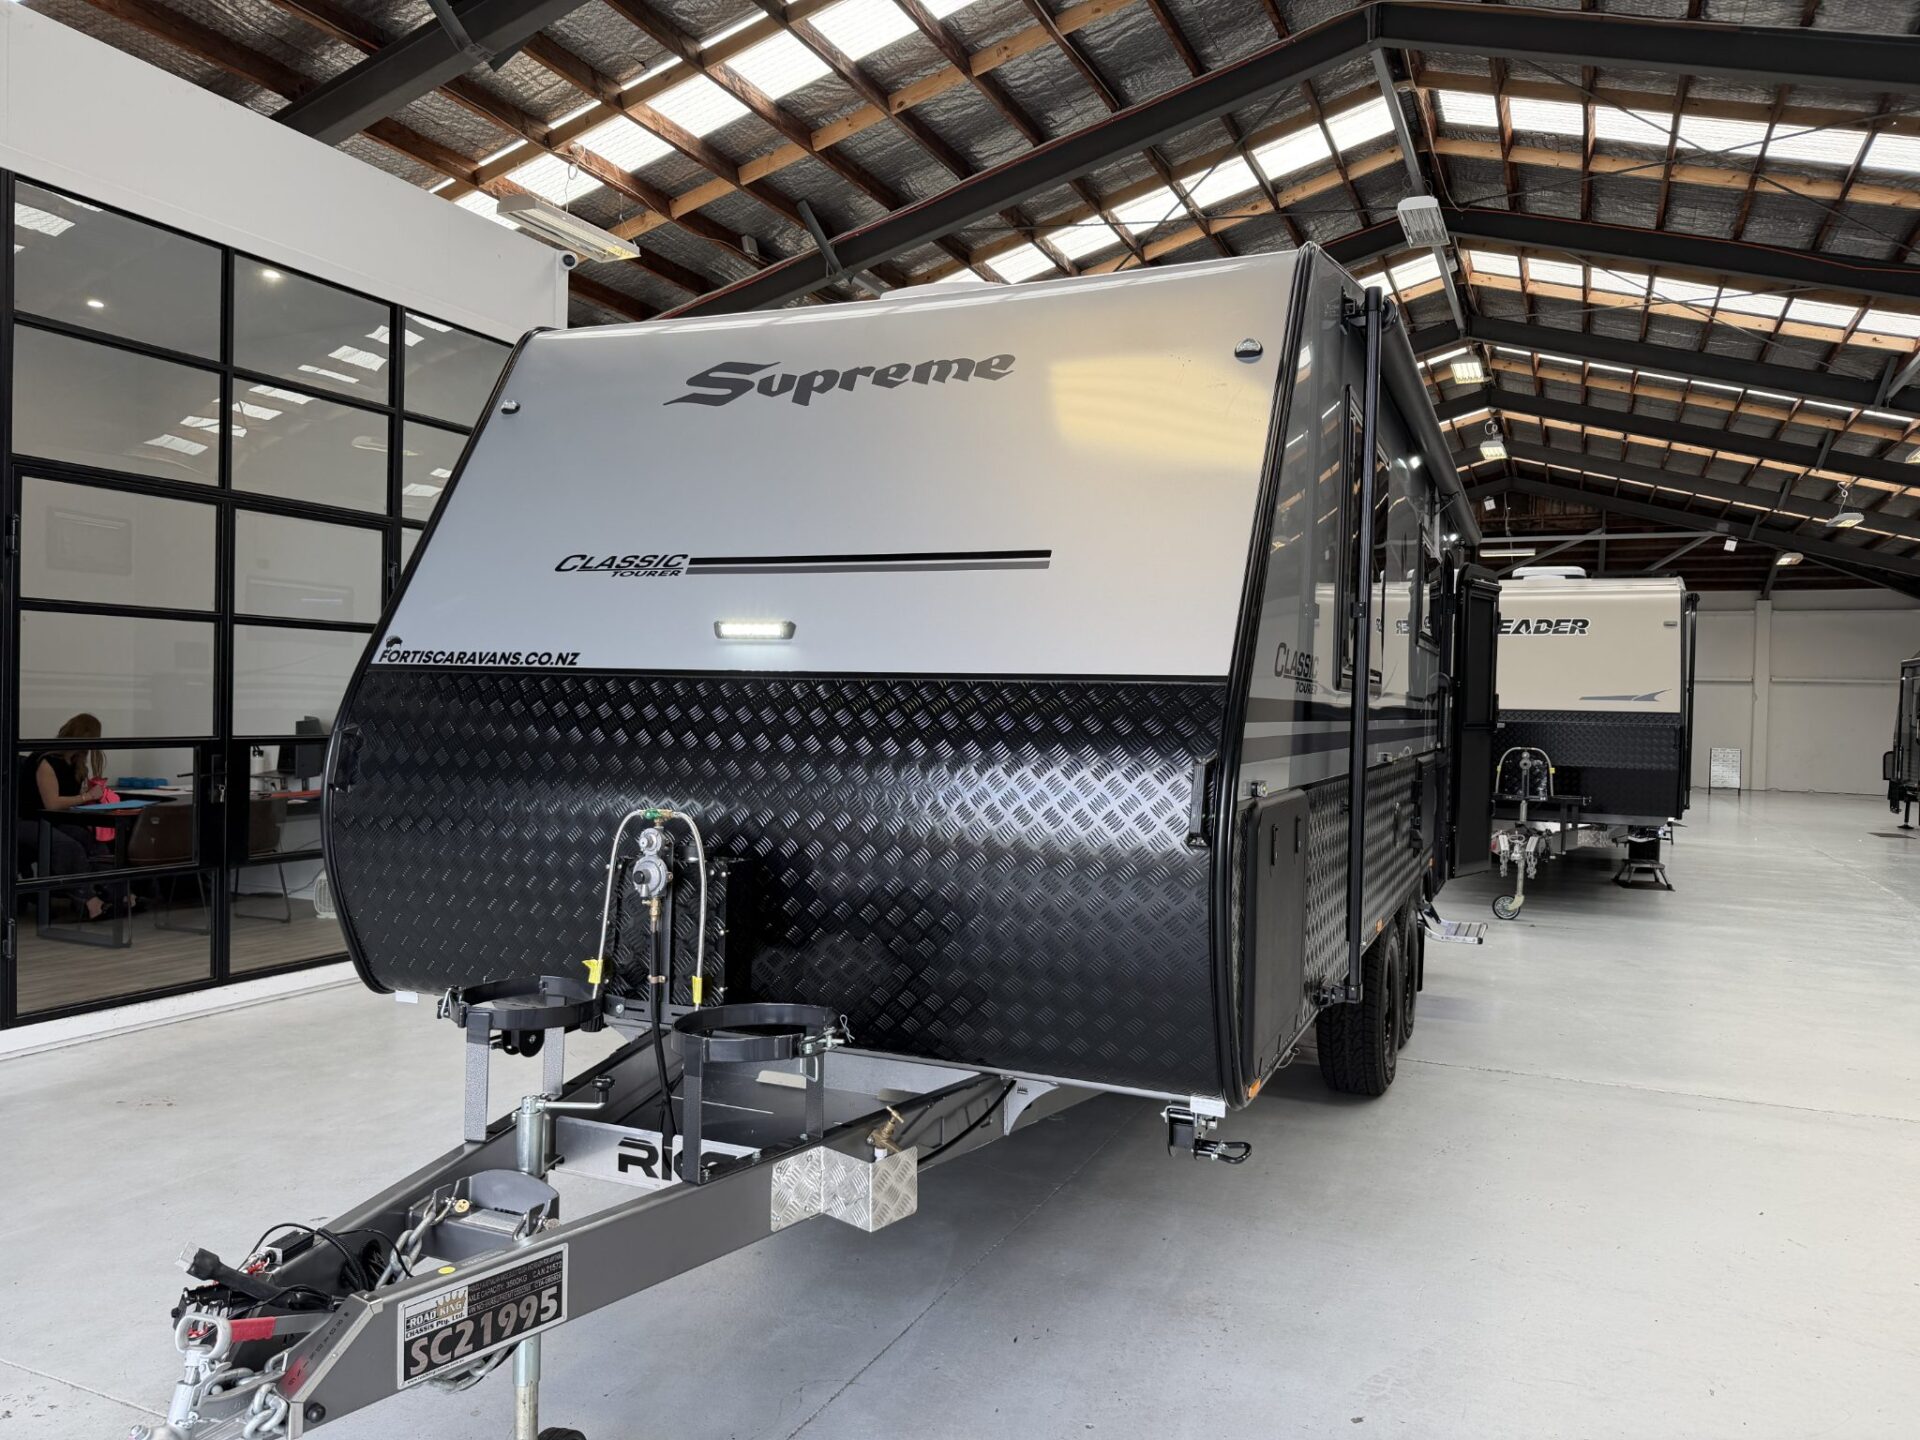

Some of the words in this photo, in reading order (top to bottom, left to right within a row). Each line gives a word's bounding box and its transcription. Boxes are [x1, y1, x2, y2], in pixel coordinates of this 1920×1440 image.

[663, 353, 1016, 407] Supreme
[555, 554, 689, 573] CLASSIC
[611, 569, 682, 578] TOURER
[1497, 617, 1591, 636] EADER
[378, 649, 581, 667] FORTISCARAVANS.CO.NZ
[409, 1310, 437, 1328] ROAD
[439, 1301, 462, 1316] KING
[405, 1322, 435, 1339] CHASSIS
[409, 1285, 560, 1376] SC21995
